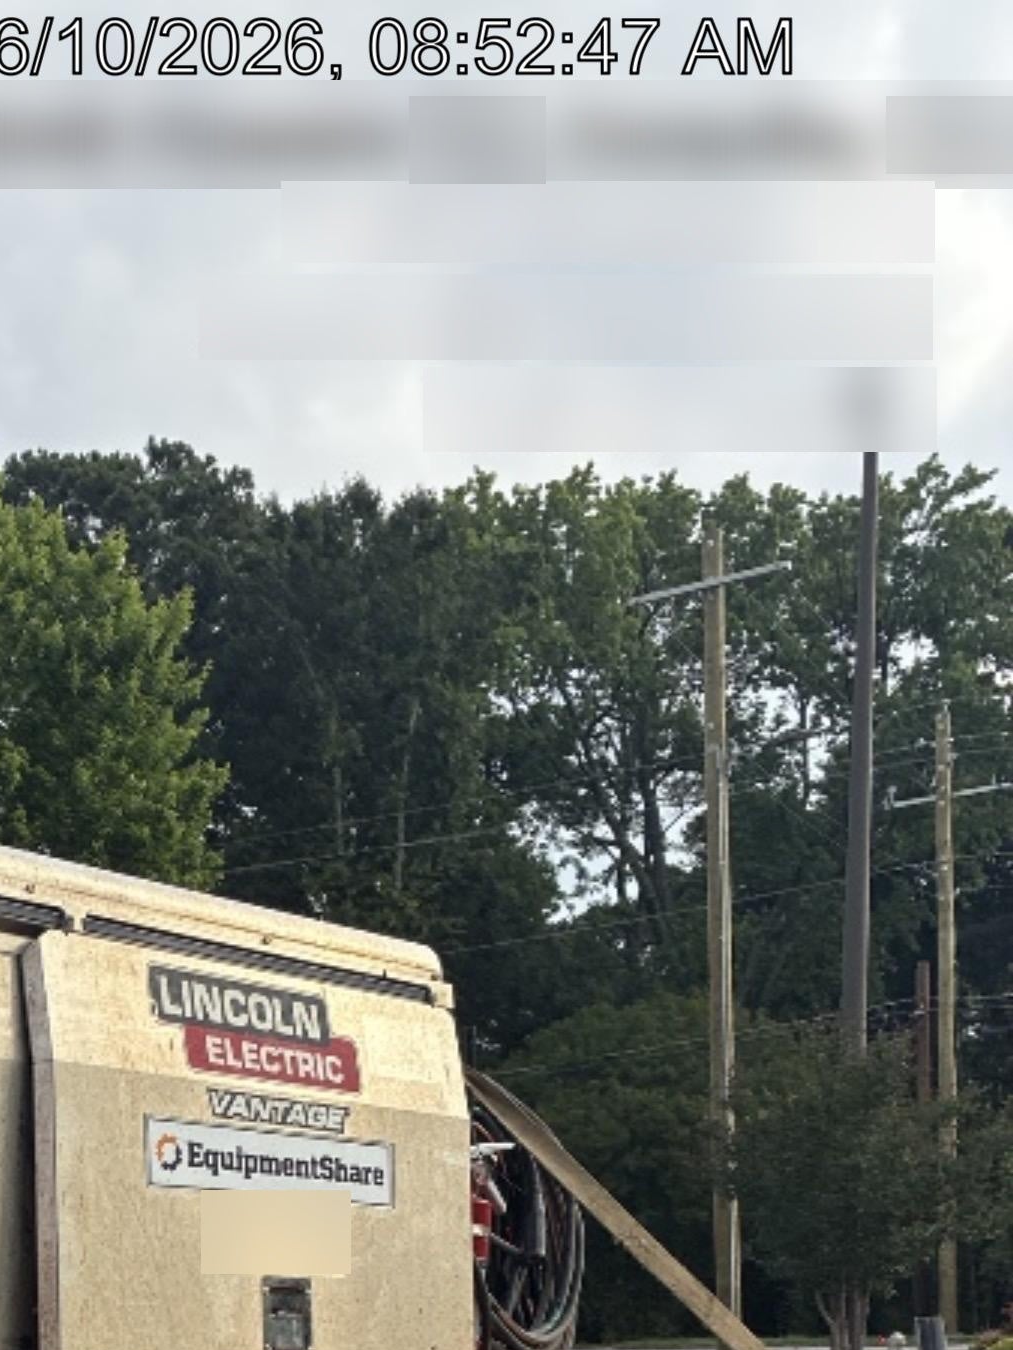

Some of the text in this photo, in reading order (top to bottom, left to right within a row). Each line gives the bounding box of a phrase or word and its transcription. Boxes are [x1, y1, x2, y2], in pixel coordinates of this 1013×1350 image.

[160, 975, 321, 1041] LINCOLN
[205, 1035, 345, 1084] ELECTRIC
[208, 1089, 348, 1132] VANTAGE
[187, 1140, 385, 1186] EquipmentShare
